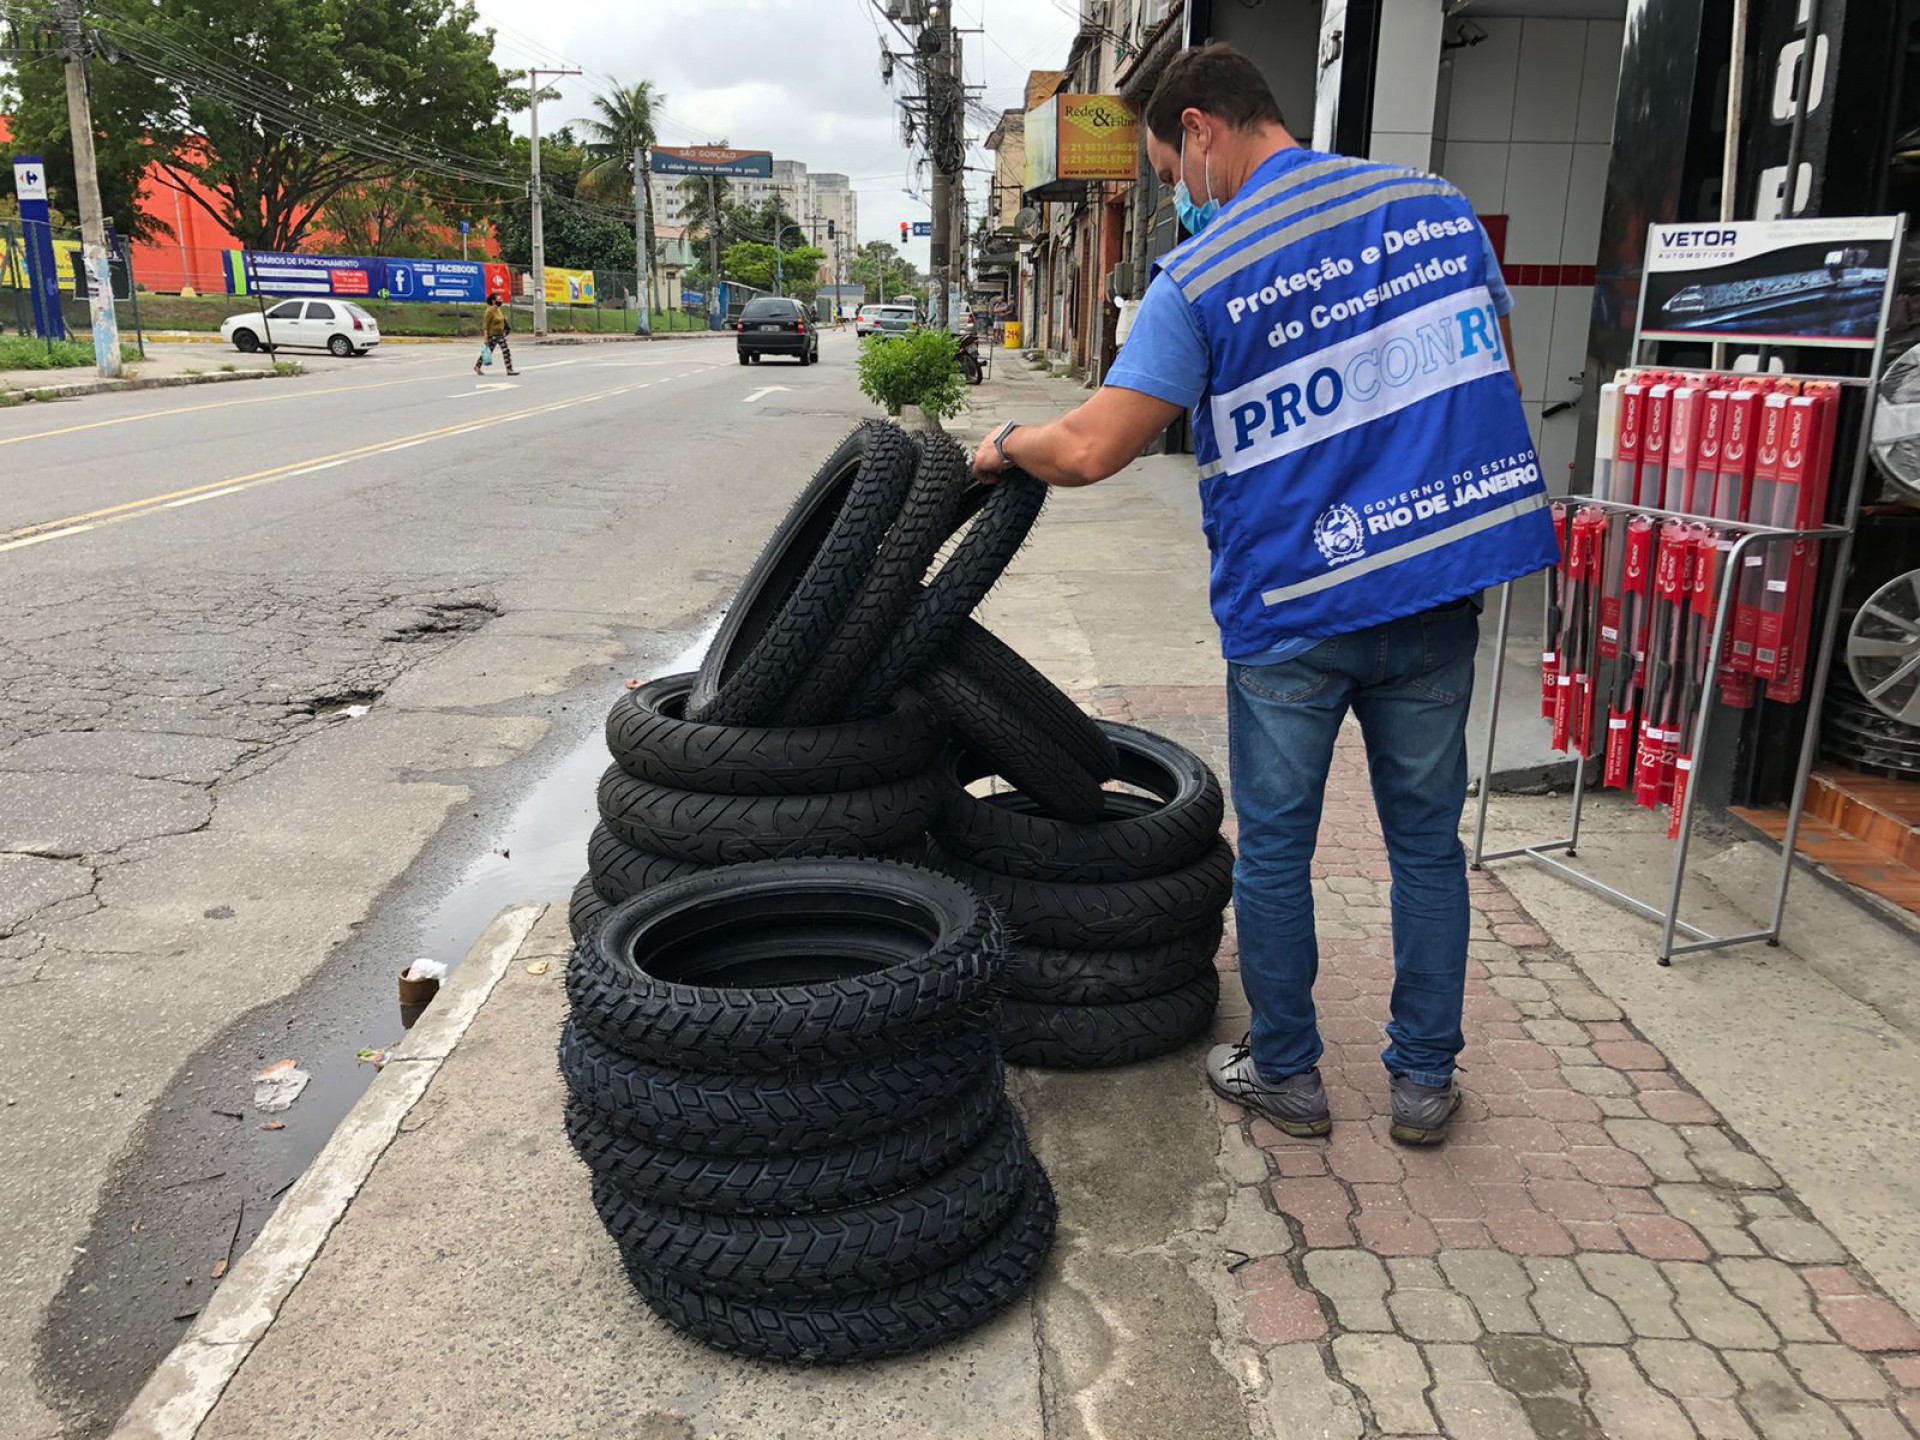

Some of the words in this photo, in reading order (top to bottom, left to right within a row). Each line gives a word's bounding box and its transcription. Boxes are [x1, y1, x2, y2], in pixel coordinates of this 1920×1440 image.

[1064, 105, 1094, 117] Rede
[1093, 107, 1111, 128] &
[680, 149, 696, 157] SÃO
[699, 150, 736, 159] GONÇALO
[1661, 230, 1737, 247] VETOR
[298, 258, 360, 268] FUNCIONAMENTO
[1658, 251, 1735, 259] AUTOMOTIVOS
[1226, 257, 1354, 324] Proteção
[1360, 245, 1382, 265] e
[1383, 215, 1475, 255] Defesa
[1267, 318, 1303, 349] do
[1310, 254, 1469, 330] Consumidor
[1363, 480, 1445, 515] GOVERNO
[1452, 470, 1473, 485] DO
[1481, 449, 1534, 476] ESTADO
[1366, 507, 1413, 535] RIO
[1414, 494, 1450, 521] DE
[1453, 463, 1538, 508] JANEIRO
[1543, 673, 1554, 685] 18
